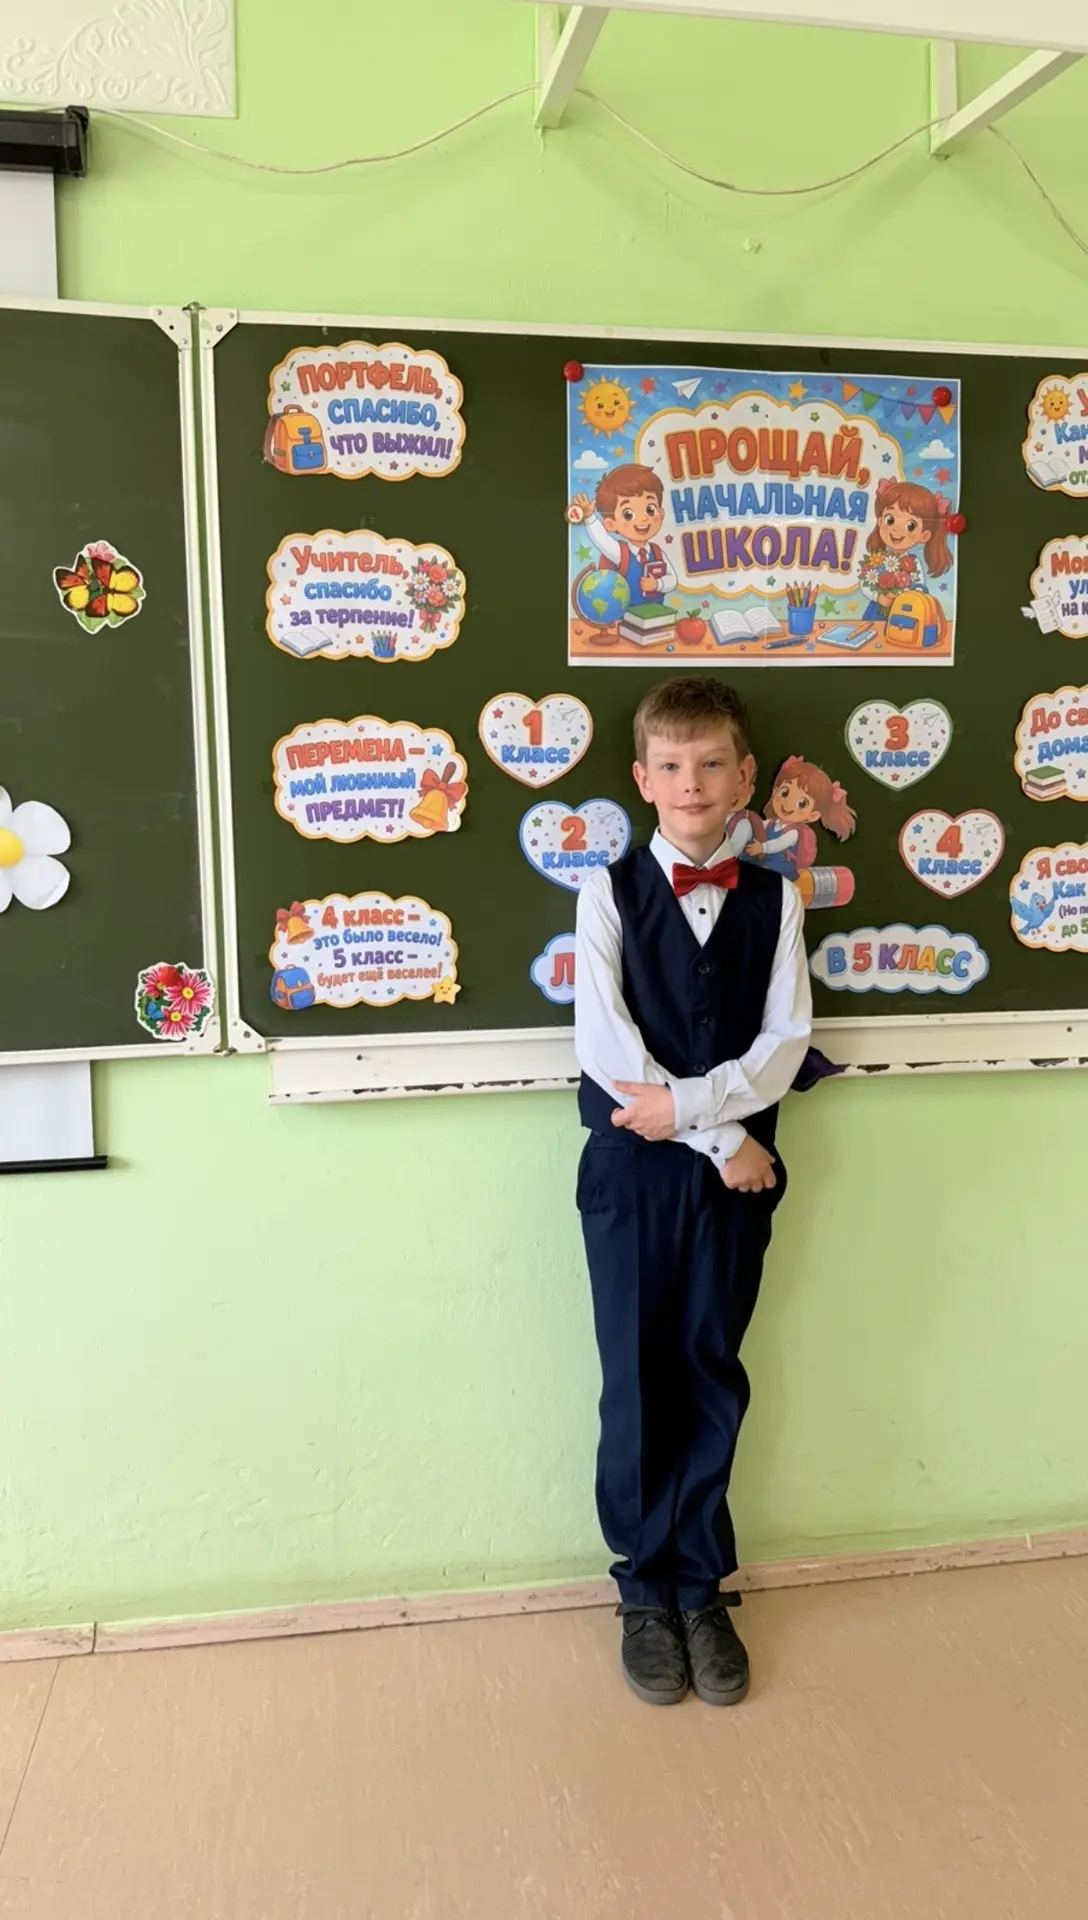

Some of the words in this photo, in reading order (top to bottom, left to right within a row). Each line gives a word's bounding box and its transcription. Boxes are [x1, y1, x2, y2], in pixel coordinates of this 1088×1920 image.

[297, 360, 443, 399] ПОРТФЕЛЬ,
[328, 398, 441, 431] СПАСИБО,
[330, 432, 367, 456] ЧТО
[372, 432, 454, 459] ВЫЖИЛ!
[665, 425, 871, 487] ПРОЩАЙ,
[670, 483, 869, 523] НАЧАЛЬНАЯ
[290, 545, 409, 579] Учитель,
[680, 526, 857, 573] ШКОЛА!
[304, 578, 392, 601] спасибо
[289, 609, 312, 626] за
[315, 608, 415, 629] терпение!
[1061, 601, 1078, 617] на
[523, 710, 542, 746] 1
[885, 715, 909, 750] 3
[1030, 707, 1061, 737] До
[286, 738, 406, 770] ПЕРЕМЕНА
[330, 768, 416, 792] ЛЮБИМЫЙ
[305, 798, 405, 823] ПРЕДМЕТ!
[561, 816, 587, 850] 2
[936, 825, 963, 858] 4
[1036, 857, 1051, 880] Я
[1052, 880, 1086, 900] Как
[321, 905, 338, 929] 4
[1061, 924, 1078, 938] до
[313, 934, 340, 950] это
[342, 928, 384, 945] было
[387, 930, 443, 947] весело!
[333, 948, 347, 968] 5
[852, 942, 872, 972] 5
[878, 943, 972, 978] КЛАСС
[317, 972, 355, 988] будет
[358, 967, 384, 982] ещё
[387, 961, 443, 979] веселее!
